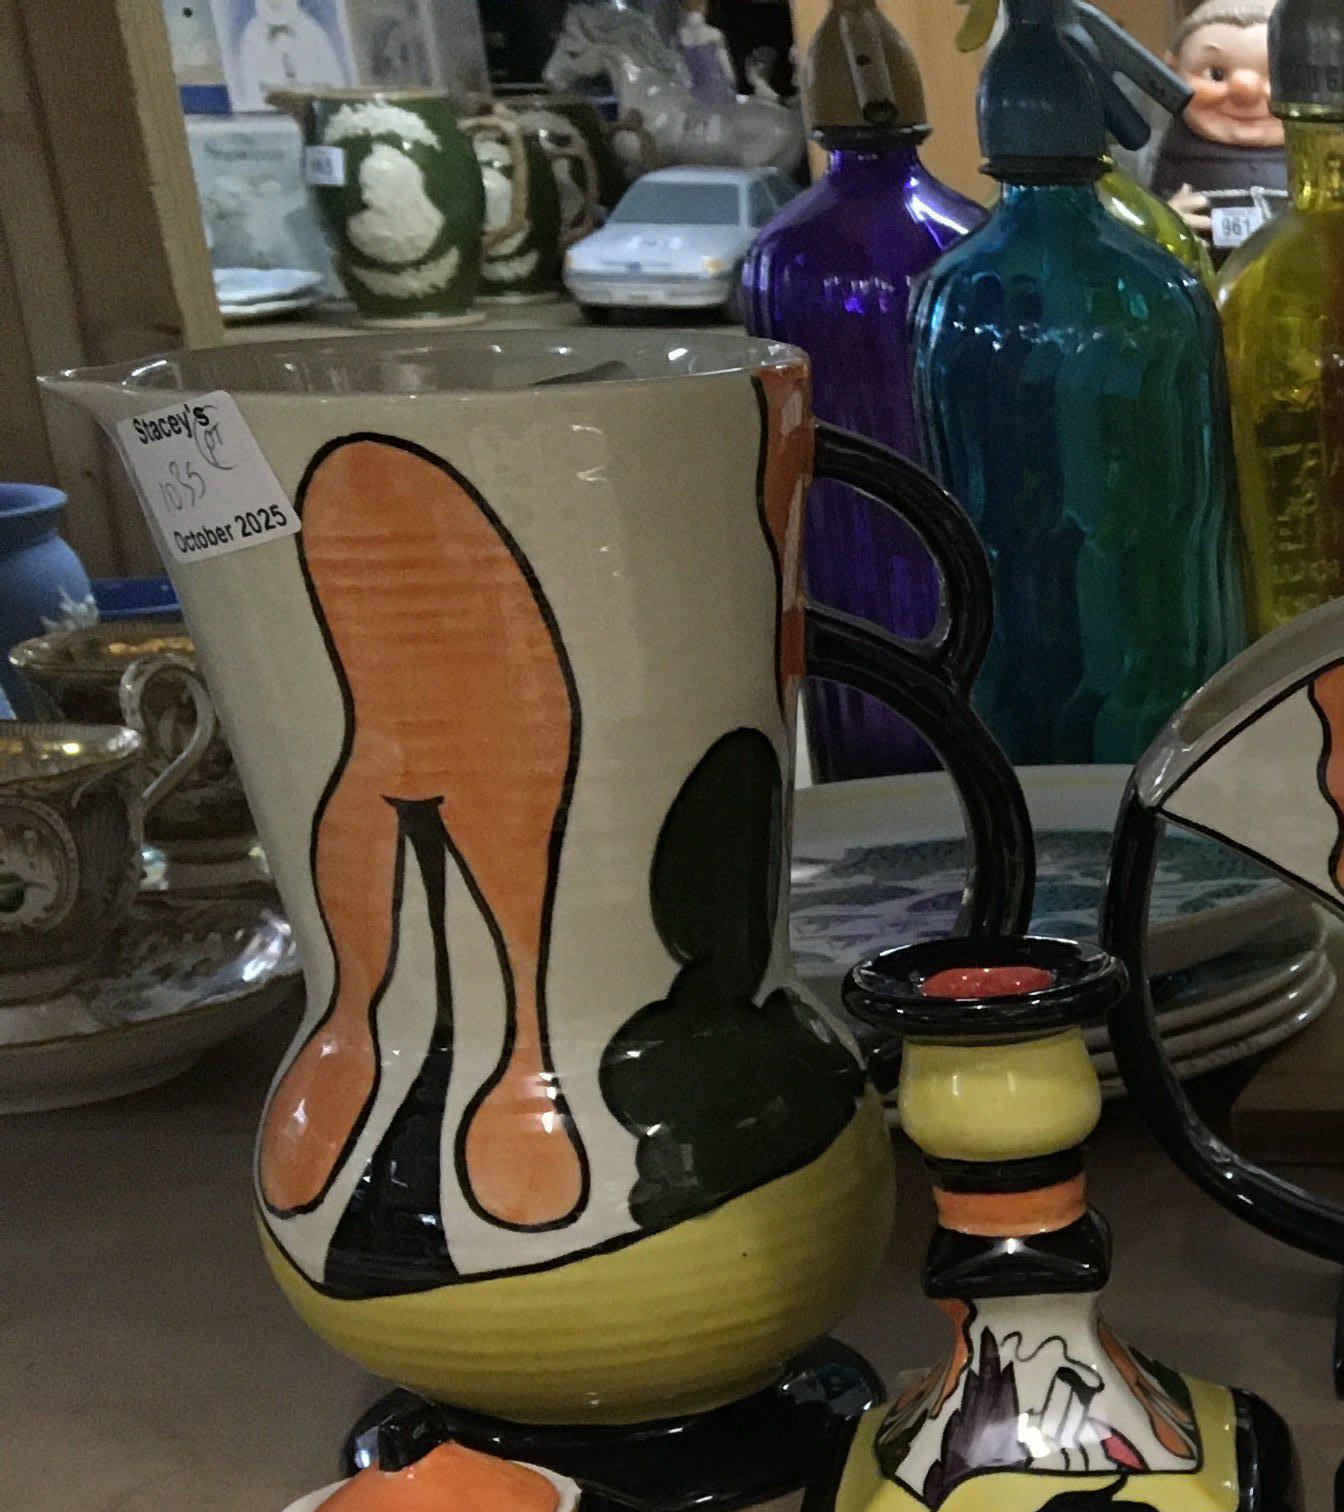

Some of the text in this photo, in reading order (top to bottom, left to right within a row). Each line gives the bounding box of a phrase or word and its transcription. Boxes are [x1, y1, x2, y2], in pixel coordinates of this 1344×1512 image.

[1221, 217, 1250, 236] 961
[133, 404, 210, 444] Stacey's
[174, 504, 288, 553] October 2025
